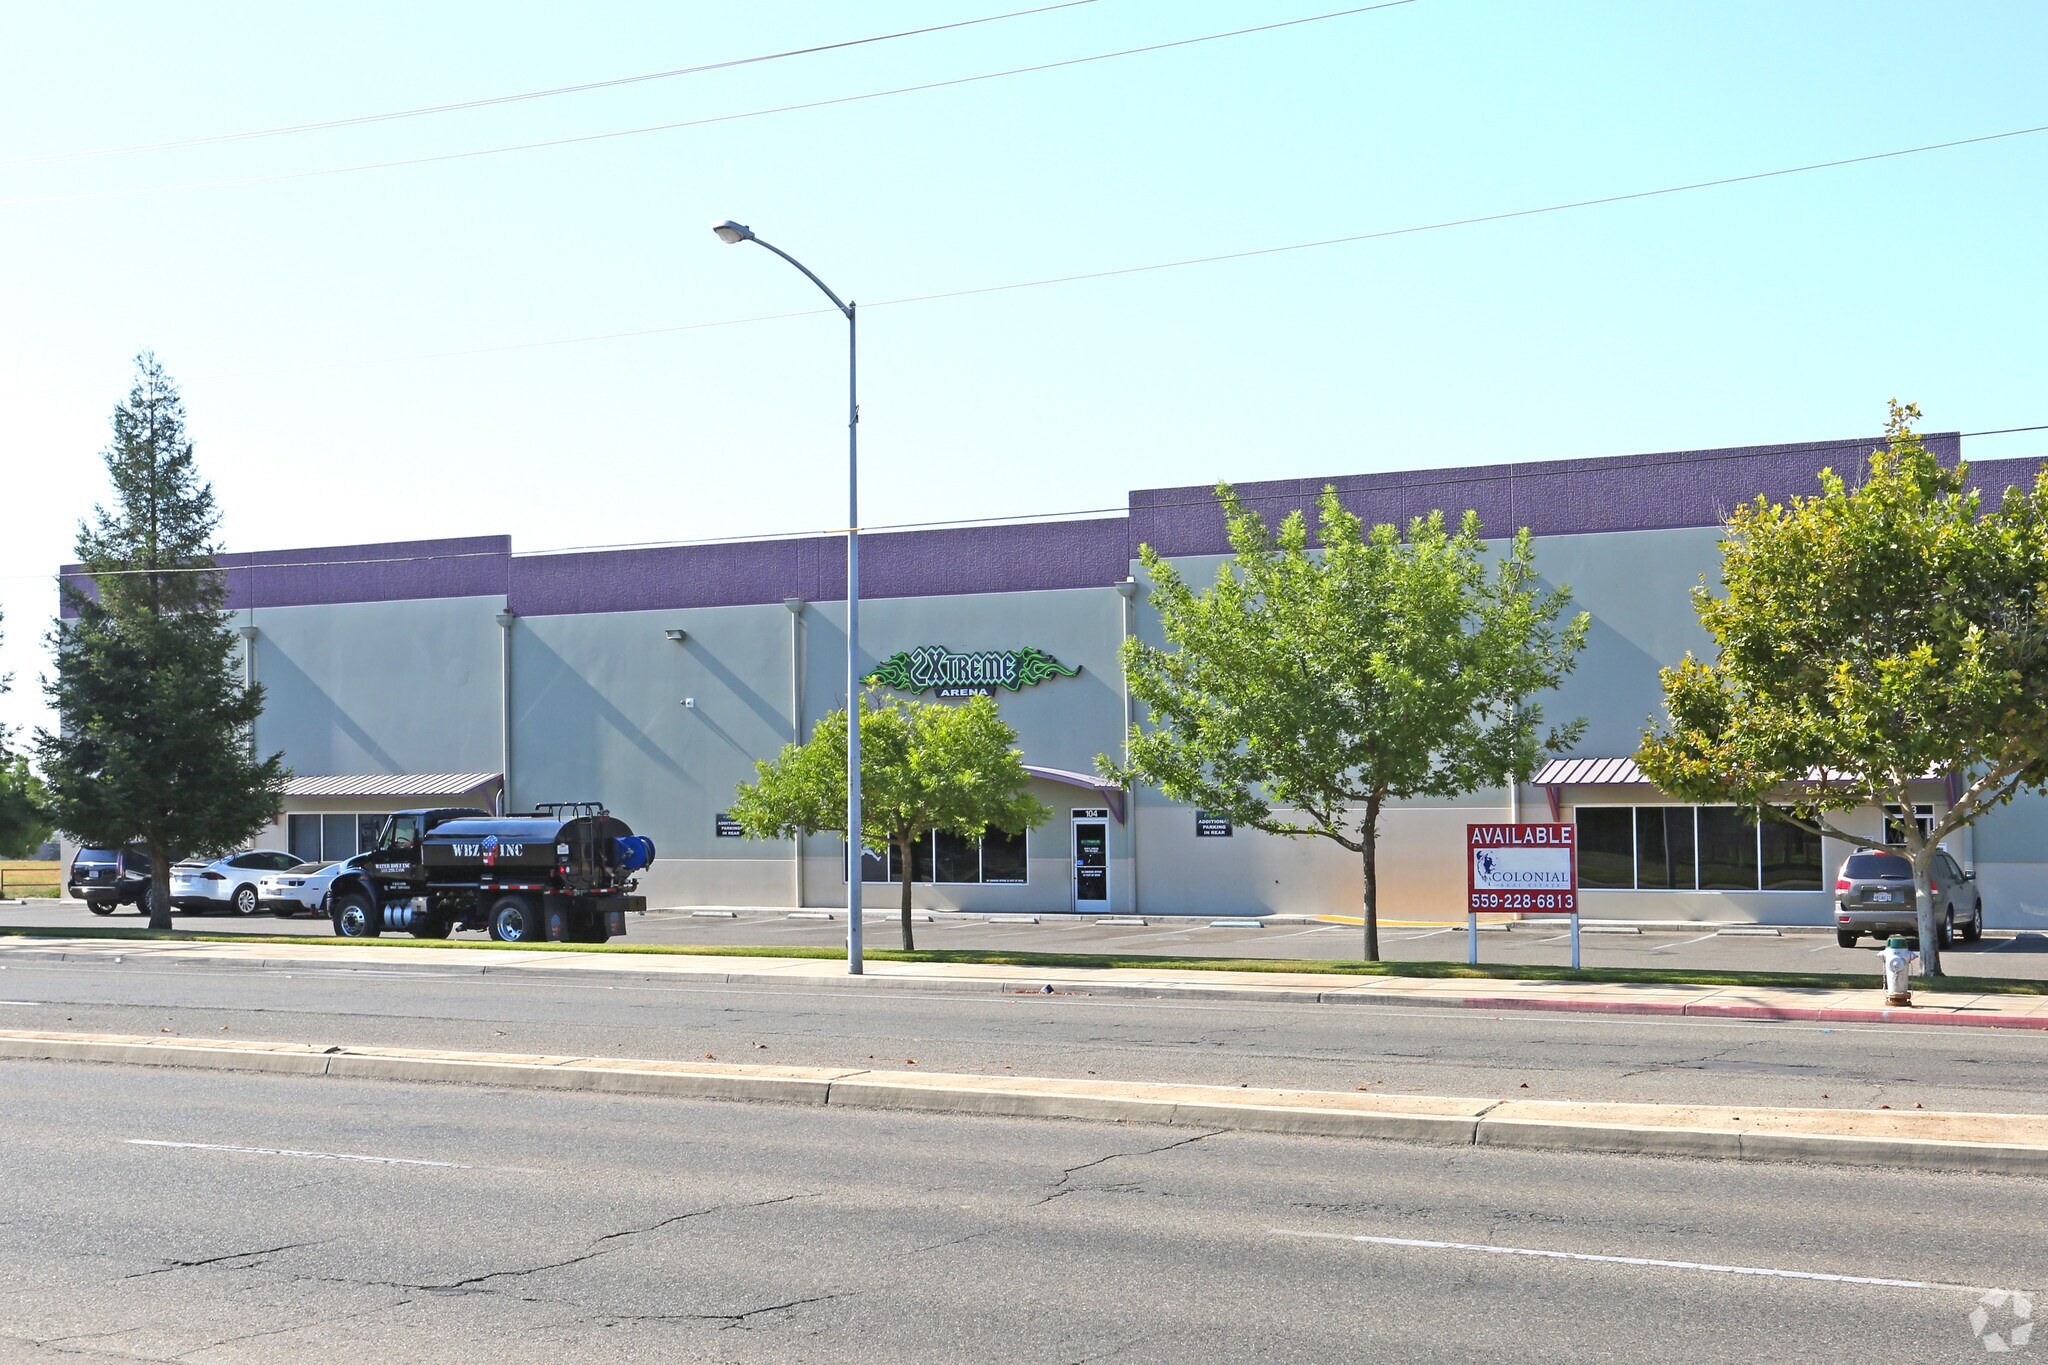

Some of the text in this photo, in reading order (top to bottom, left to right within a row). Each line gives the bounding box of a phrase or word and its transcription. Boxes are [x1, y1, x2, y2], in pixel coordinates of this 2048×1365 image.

[940, 688, 988, 697] ARENA
[1085, 810, 1098, 818] 104
[1471, 827, 1572, 844] AVAILABLE
[452, 844, 523, 857] WBZ INC
[1492, 871, 1569, 882] COLONIAL
[1471, 893, 1574, 908] 559-228-6813
